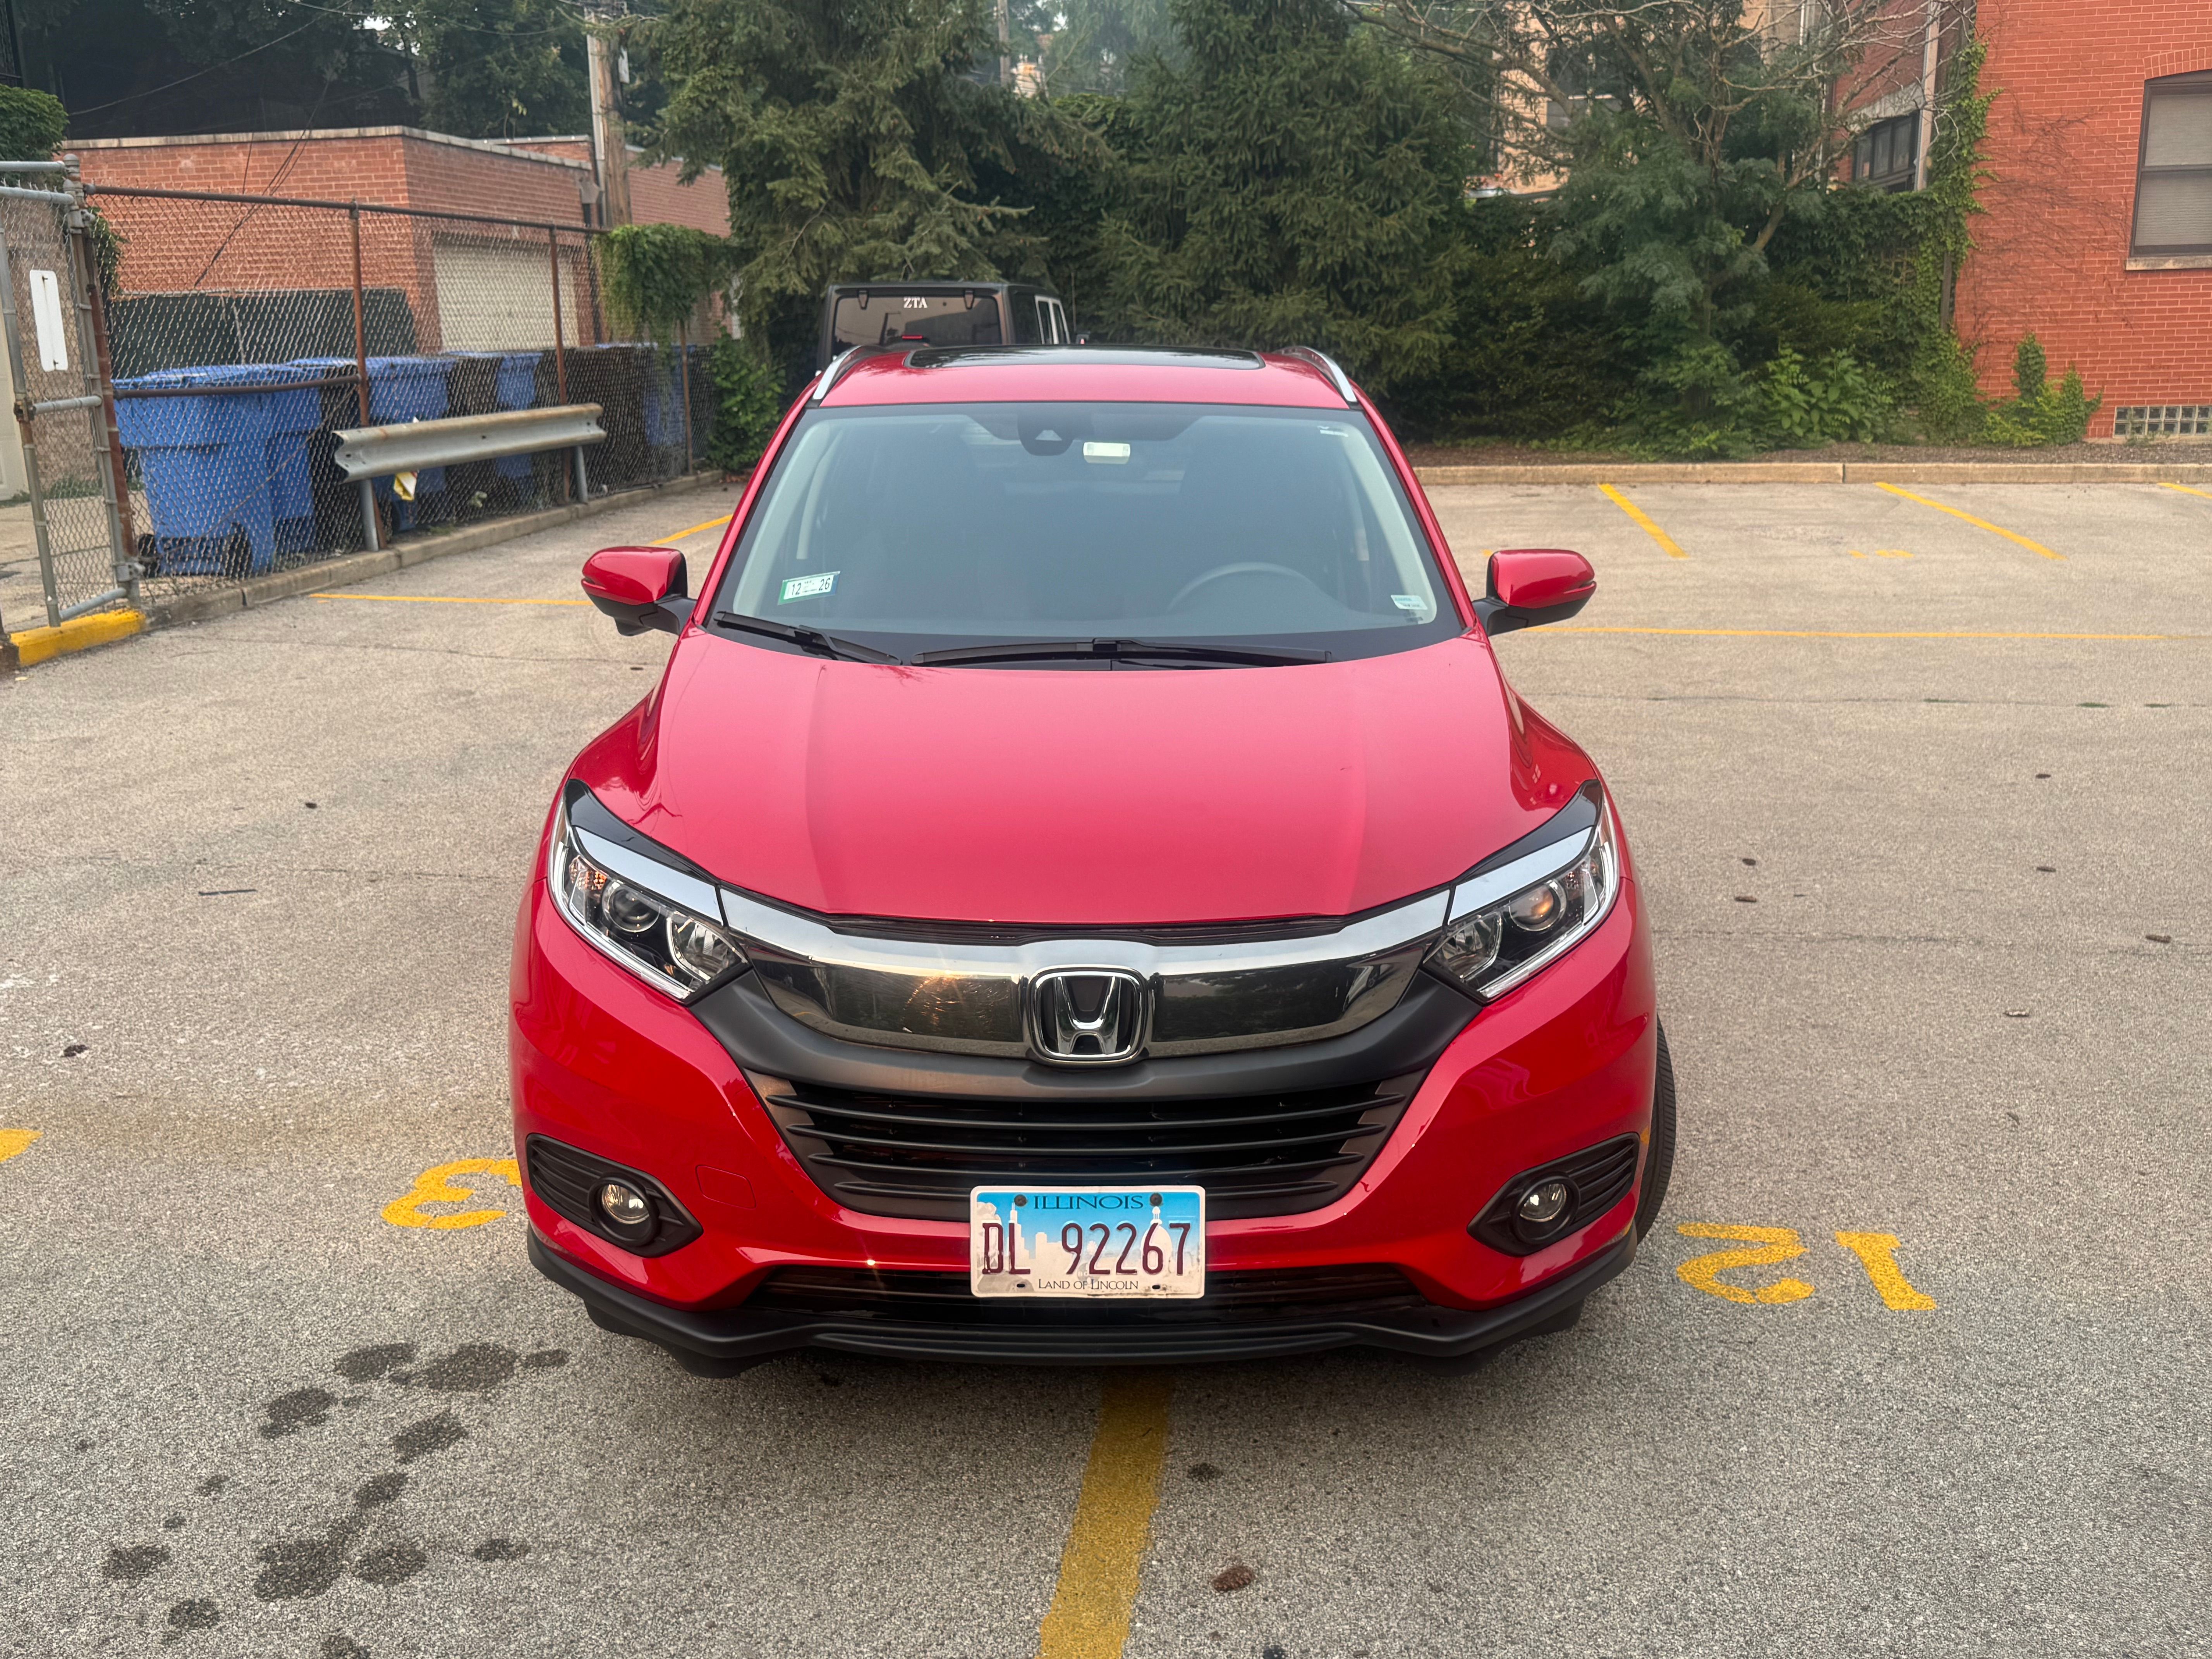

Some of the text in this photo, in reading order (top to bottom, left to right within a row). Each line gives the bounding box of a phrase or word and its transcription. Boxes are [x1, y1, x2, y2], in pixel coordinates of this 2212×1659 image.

[903, 296, 927, 308] ZTA
[792, 577, 831, 595] 12 26
[1034, 1195, 1144, 1209] ILLINOIS
[982, 1222, 1191, 1276] DL 92267
[1676, 1222, 1937, 1311] 12
[1039, 1279, 1070, 1289] LAND
[1091, 1279, 1138, 1290] LINCOLN
